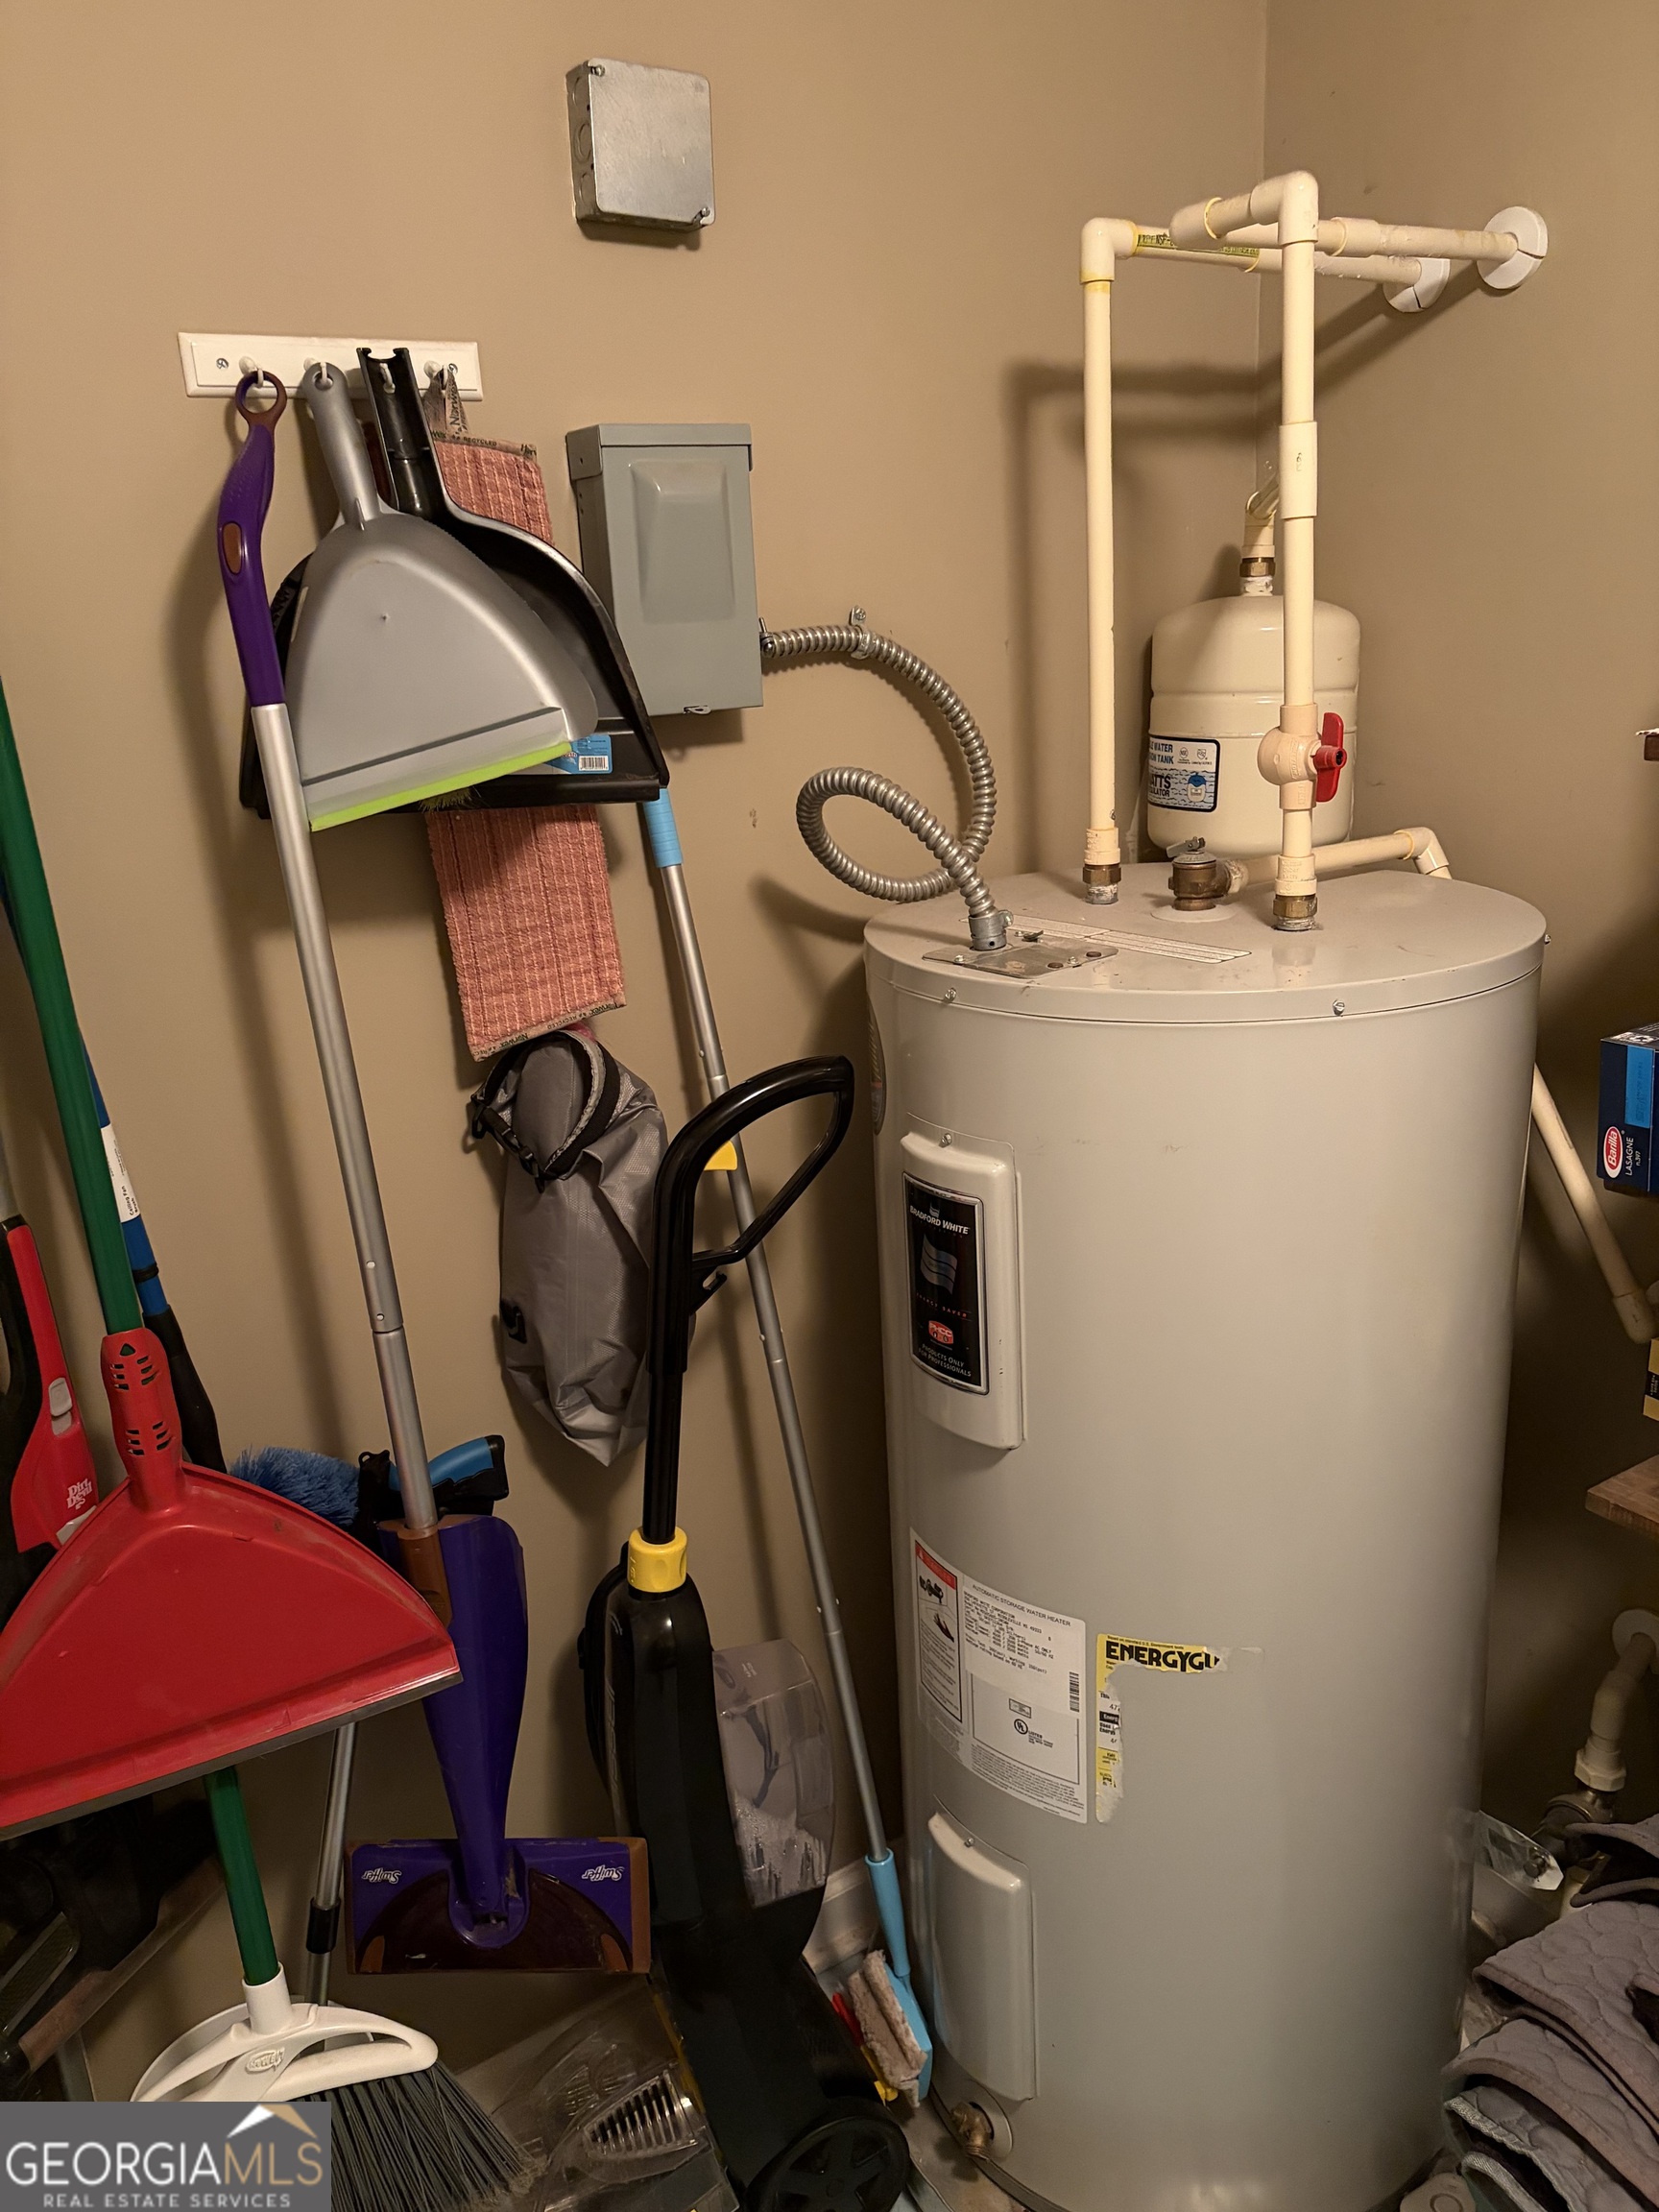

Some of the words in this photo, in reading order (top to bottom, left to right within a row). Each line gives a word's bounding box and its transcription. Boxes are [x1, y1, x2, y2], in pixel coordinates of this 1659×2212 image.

[1158, 755, 1174, 764] TANK
[1151, 774, 1171, 789] ATTS
[1606, 1130, 1619, 1167] Barilla
[1624, 1137, 1635, 1176] LASAGNE
[909, 1205, 942, 1227] BRADFORD
[942, 1219, 969, 1236] WHITE
[927, 1352, 972, 1377] PROFESSIONALS
[948, 1355, 965, 1368] ONLY
[972, 1584, 1000, 1601] AUTOMATIC
[1000, 1598, 1025, 1613] STORAGE
[1026, 1608, 1046, 1619] WATER
[1047, 1614, 1071, 1626] HEATER
[361, 1867, 402, 1885] Swiffer
[581, 1864, 625, 1882] Swiffer
